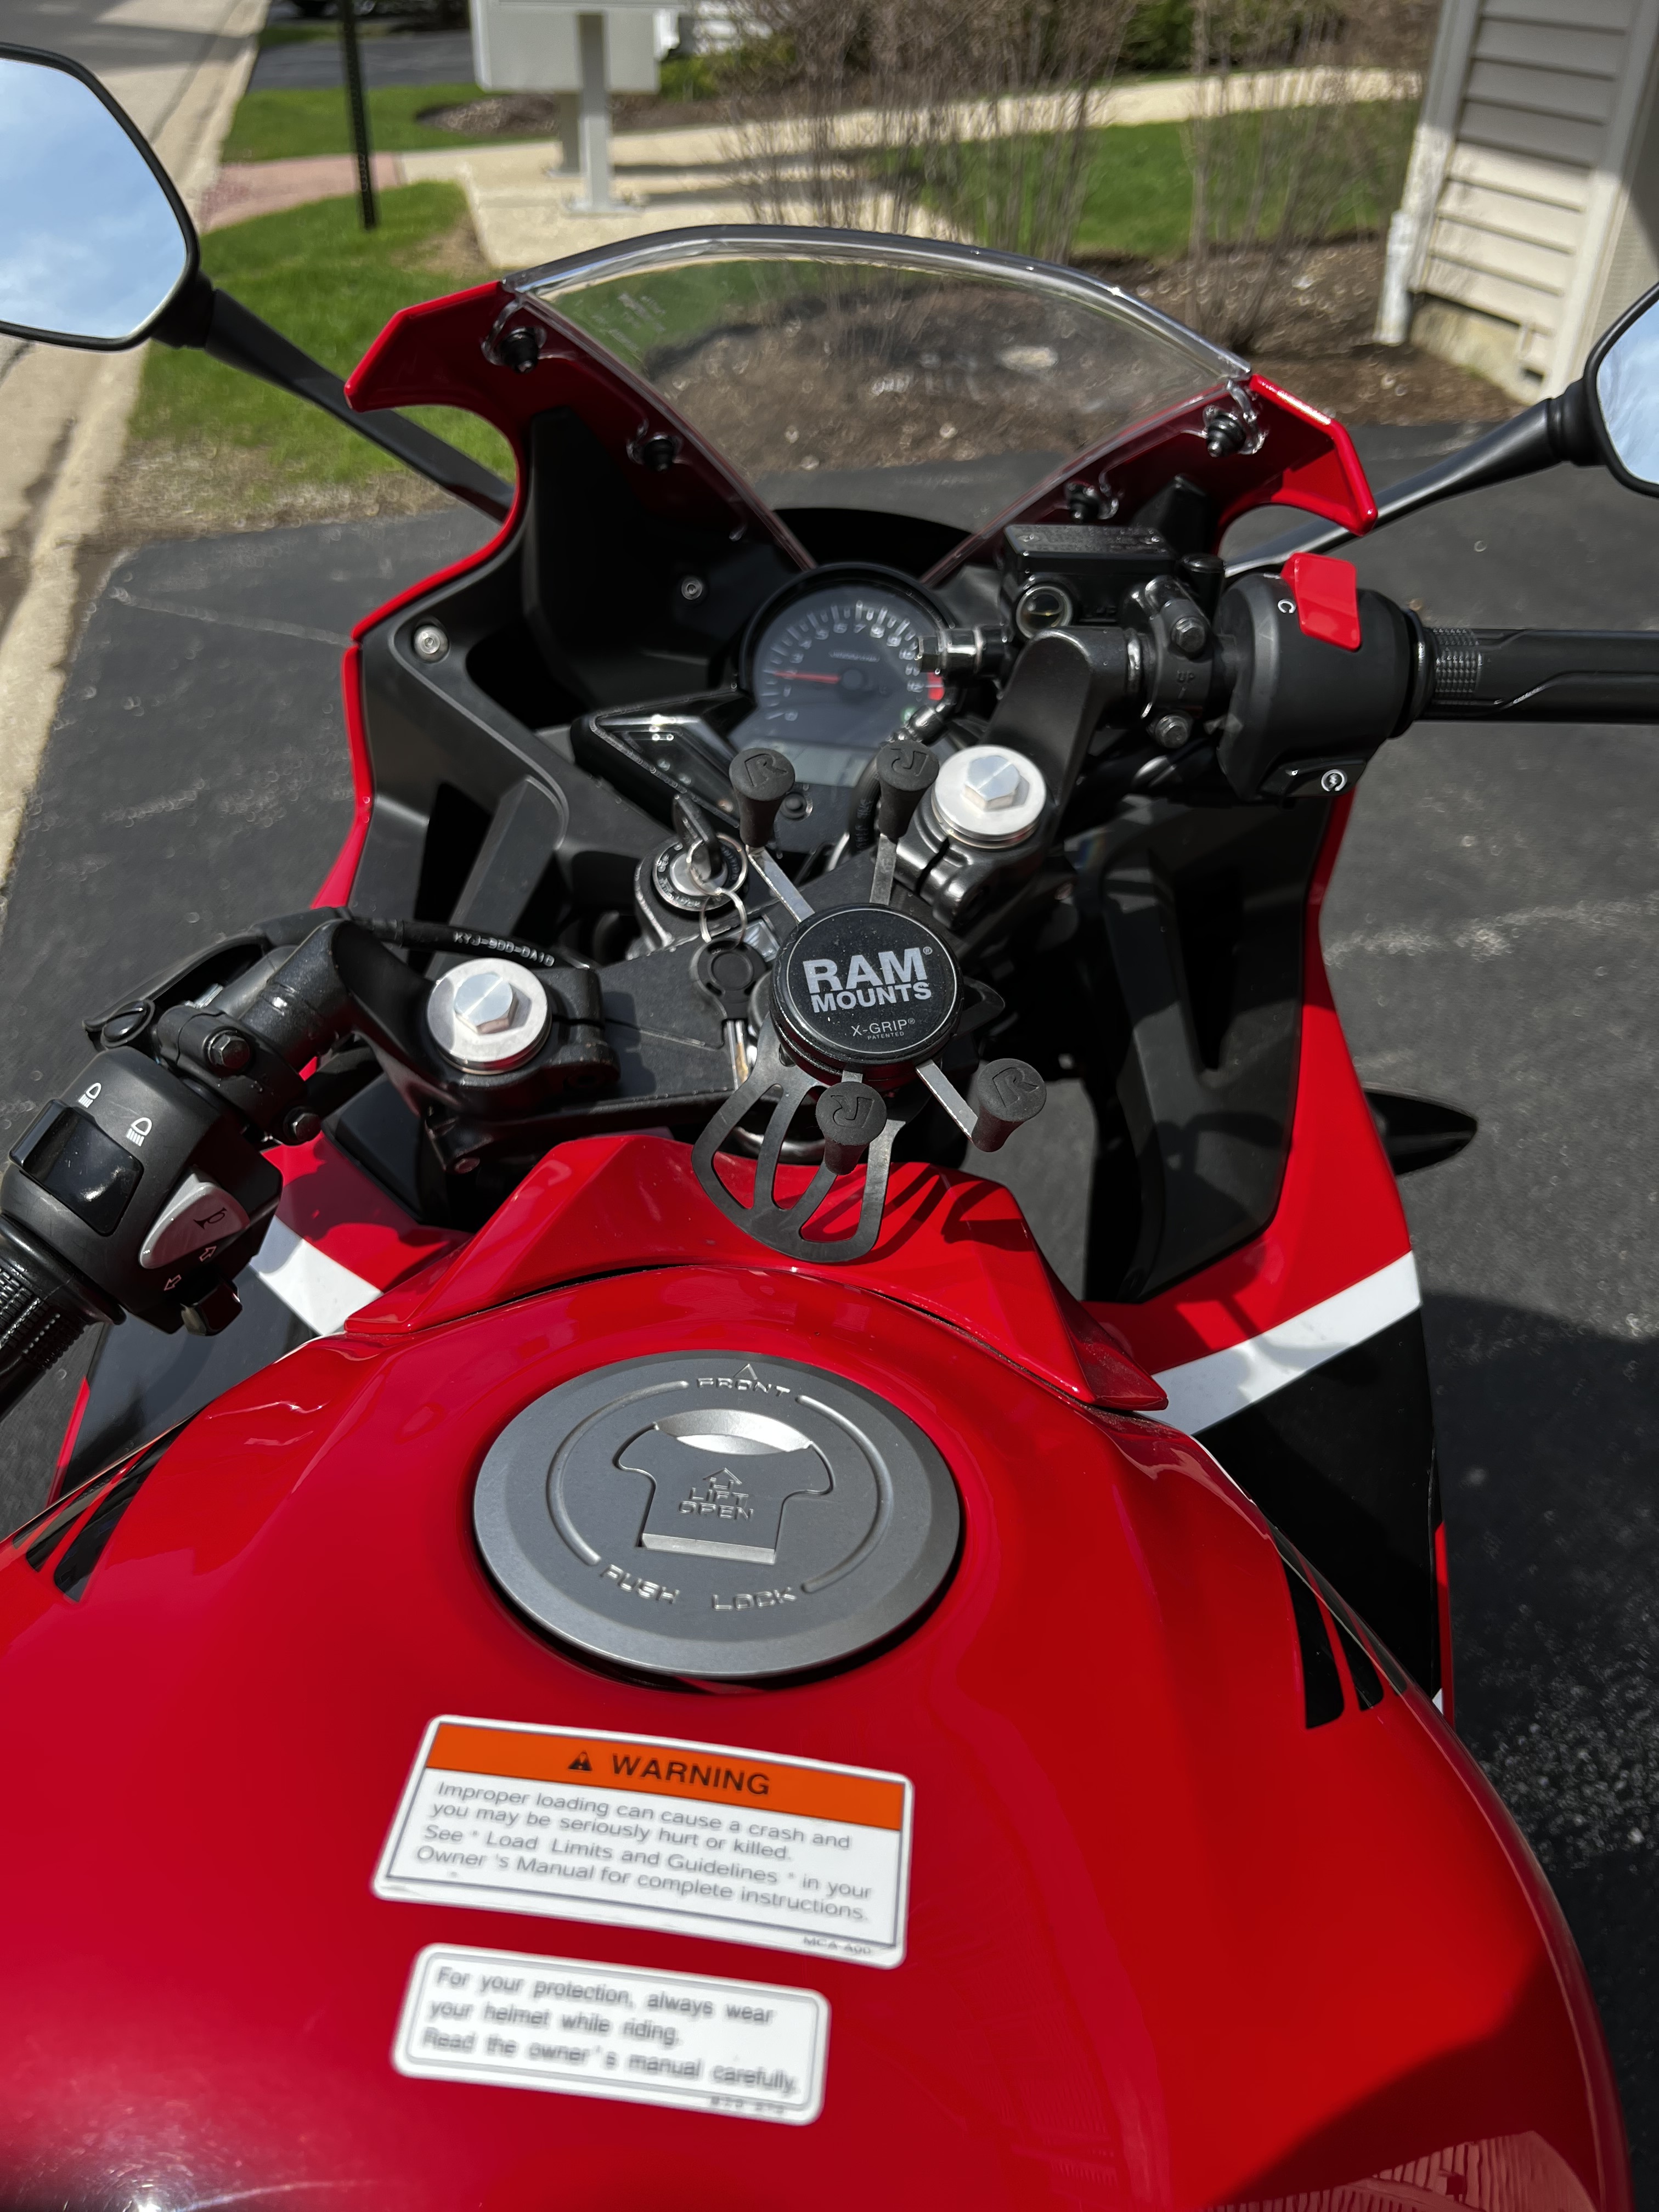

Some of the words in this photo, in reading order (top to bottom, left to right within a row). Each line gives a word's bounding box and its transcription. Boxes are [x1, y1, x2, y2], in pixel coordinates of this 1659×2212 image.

[810, 981, 932, 1013] MOUNTS
[867, 1030, 905, 1041] PATENTED
[696, 1376, 791, 1397] FRONT
[678, 1500, 754, 1520] OPEN
[688, 1487, 749, 1506] LIFT
[600, 1563, 681, 1605] PUSH
[711, 1585, 798, 1612] LOCK
[612, 1752, 770, 1796] WARNING
[431, 1803, 469, 1818] you
[476, 1808, 519, 1826] may
[526, 1811, 551, 1826] be
[559, 1816, 652, 1843] seriously
[658, 1827, 699, 1846] hurt
[706, 1836, 726, 1850] or
[733, 1838, 792, 1861] killed.
[438, 1781, 531, 1805] Improper
[535, 1792, 610, 1817] loading
[616, 1804, 654, 1820] can
[661, 1810, 723, 1829] cause
[729, 1820, 741, 1832] a
[748, 1823, 805, 1842] crash
[812, 1832, 851, 1849] and
[424, 1824, 464, 1842] See
[486, 1830, 539, 1850] Load
[551, 1837, 613, 1859] Limits
[621, 1849, 660, 1866] and
[667, 1853, 778, 1883] Guidelines
[802, 1874, 820, 1890] in
[826, 1880, 873, 1899] your
[516, 1856, 595, 1880] Manual
[600, 1865, 633, 1884] for
[637, 1874, 733, 1899] complete
[740, 1886, 868, 1921] instructions.
[437, 1966, 471, 1986] For
[479, 1974, 526, 1994] your
[533, 1980, 634, 2008] protection,
[647, 1991, 715, 2017] always
[725, 2002, 775, 2023] wear
[430, 2001, 474, 2018] your
[484, 2001, 552, 2027] helmet
[561, 2011, 612, 2033] while
[623, 2018, 683, 2046] riding.
[422, 2027, 477, 2051] Read
[487, 2034, 517, 2054] the
[628, 2053, 702, 2077] manual
